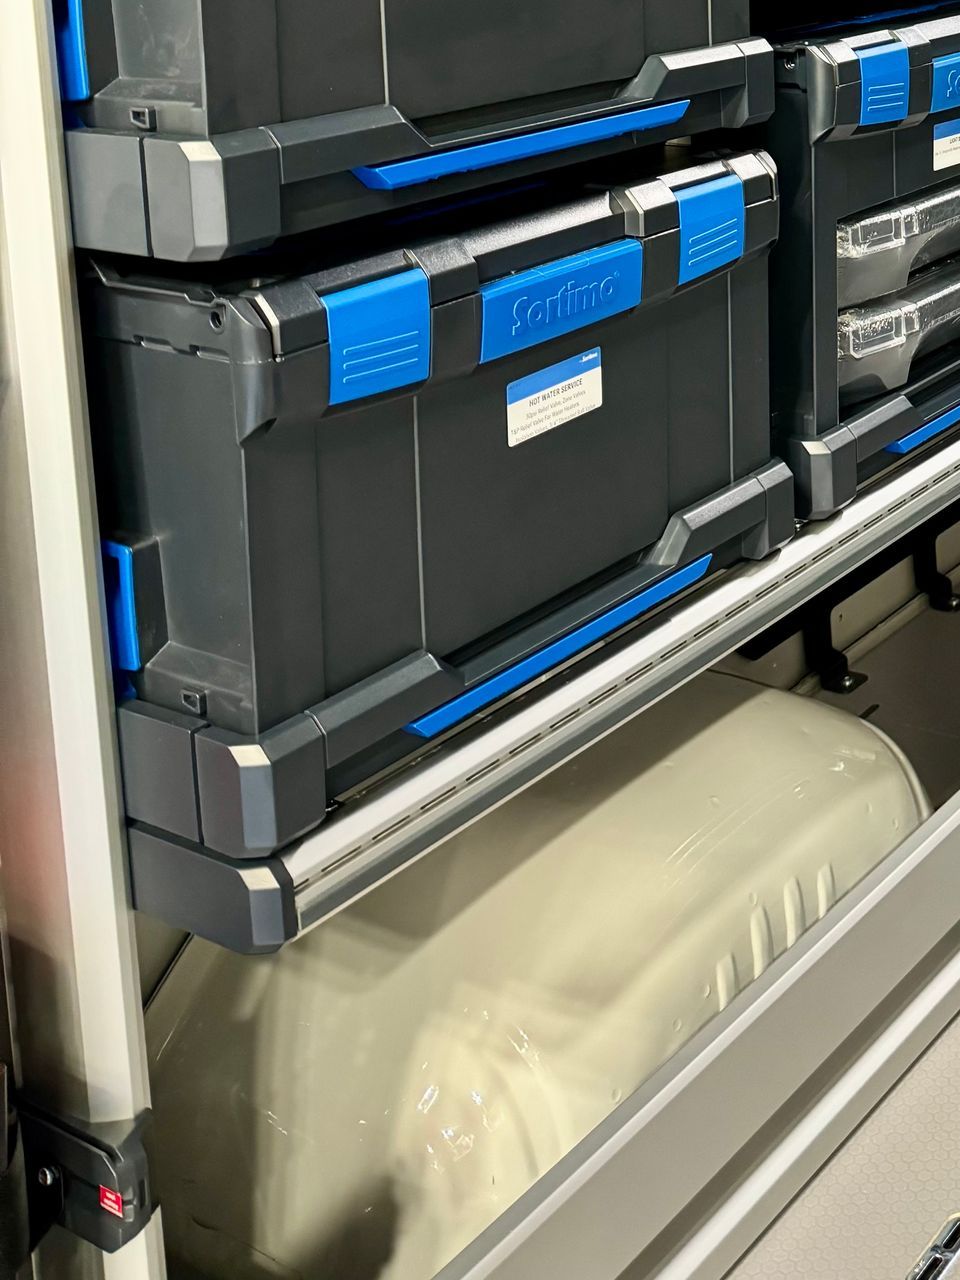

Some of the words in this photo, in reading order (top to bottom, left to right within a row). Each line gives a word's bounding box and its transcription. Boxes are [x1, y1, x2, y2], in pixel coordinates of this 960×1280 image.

[512, 274, 619, 336] Sortimo
[530, 396, 540, 407] HOT
[542, 388, 560, 402] WATER
[562, 378, 582, 393] SERVICE
